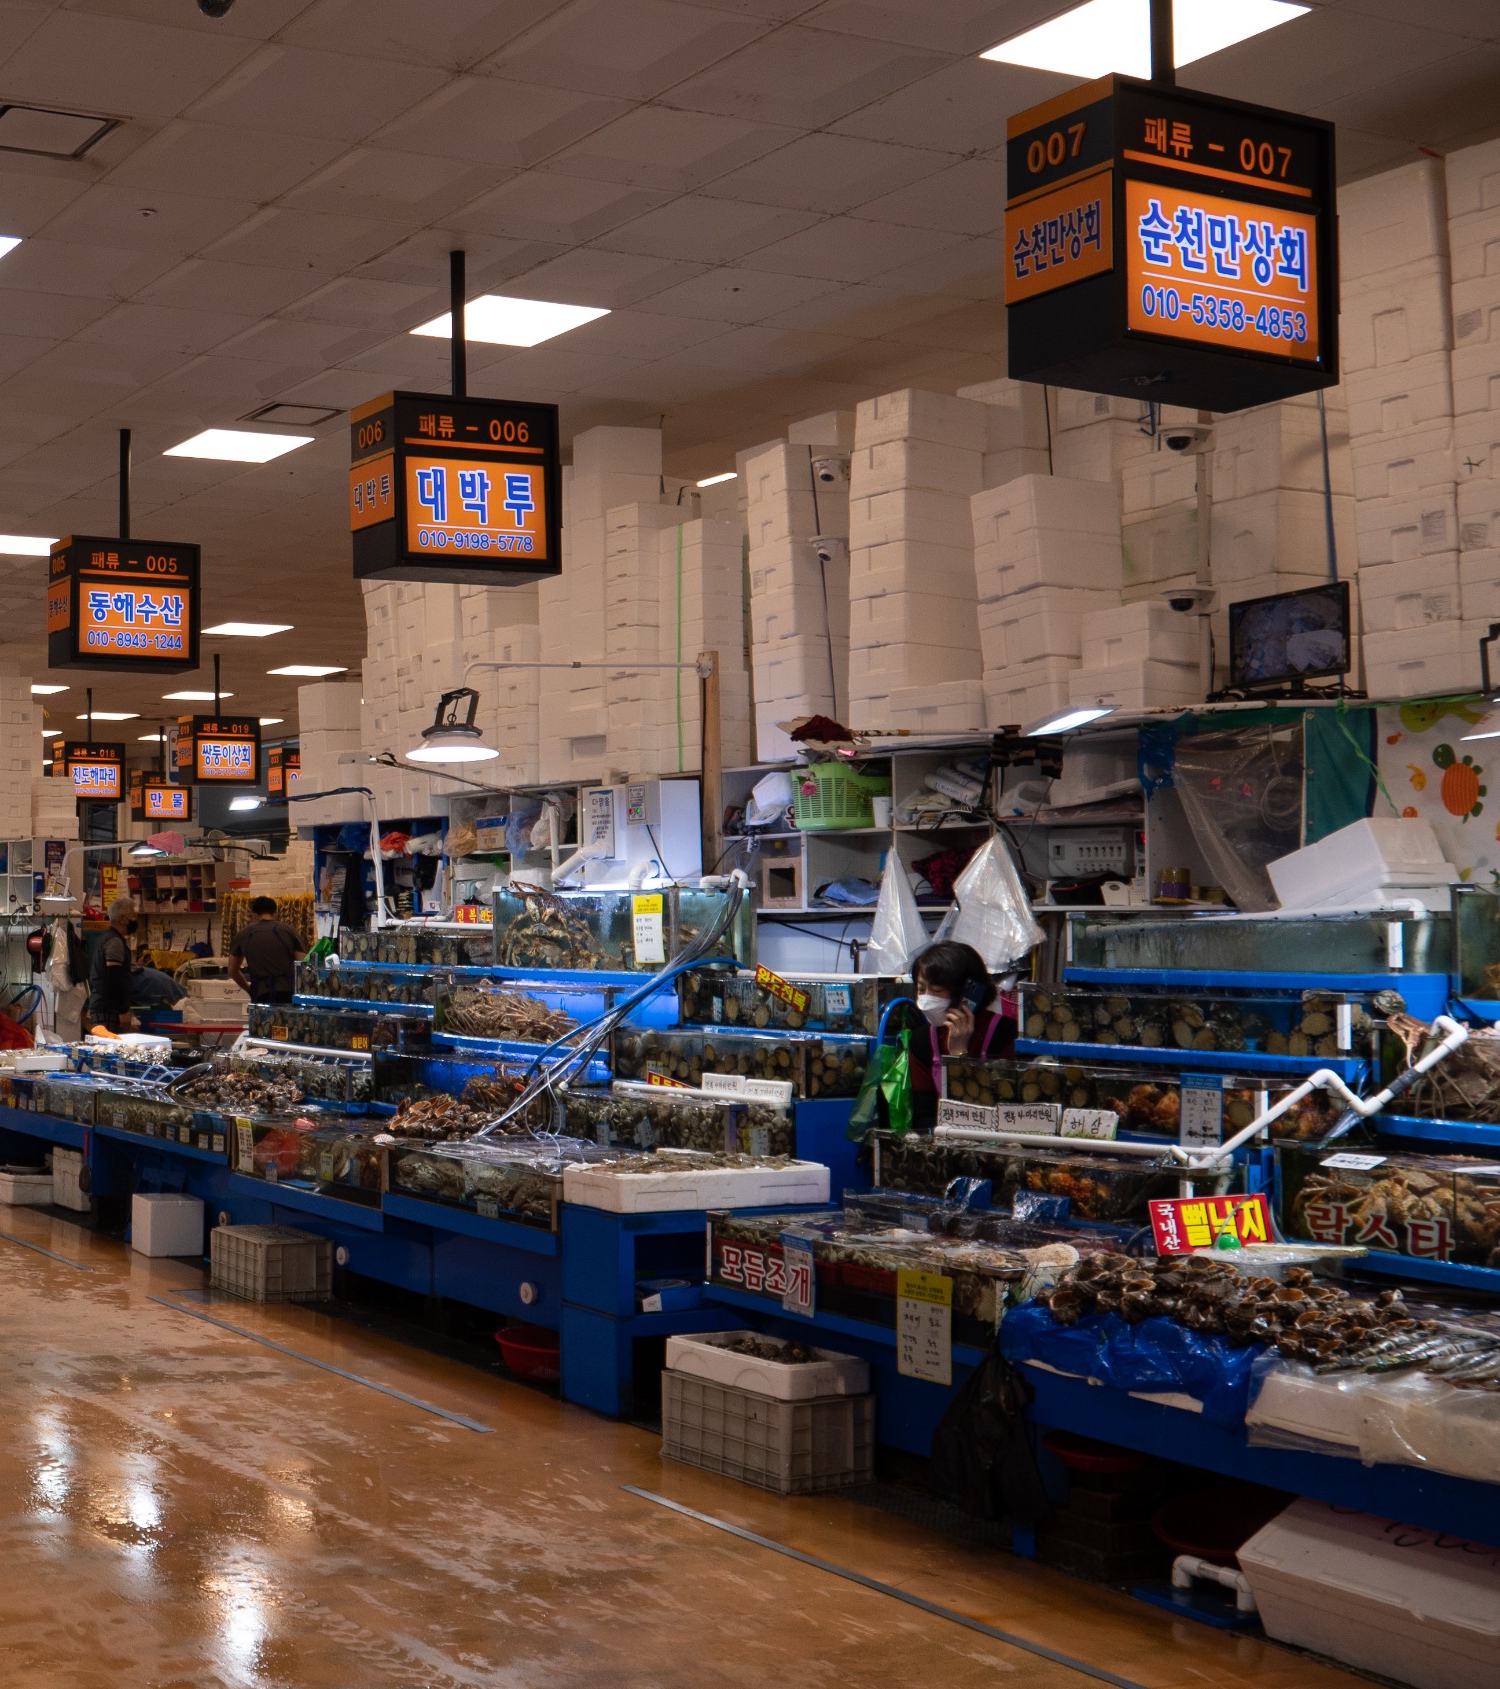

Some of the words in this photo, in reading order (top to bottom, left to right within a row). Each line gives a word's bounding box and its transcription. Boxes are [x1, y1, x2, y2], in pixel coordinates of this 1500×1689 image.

[1028, 122, 1087, 174] 007
[1144, 118, 1193, 158] 패류
[1240, 138, 1292, 177] 007
[1013, 200, 1101, 279] 순천만상회
[1139, 199, 1309, 293] 순천만상회
[1142, 284, 1307, 343] 010-5358-4853
[358, 420, 383, 448] 006
[418, 414, 455, 438] 패류
[489, 420, 529, 443] 006
[419, 530, 534, 552] 010-9198-5778
[52, 555, 66, 574] 005
[91, 552, 120, 569] 패류
[147, 556, 178, 573] 005
[88, 591, 184, 626] 동해수산
[87, 631, 183, 650] 010-8943-1244
[232, 724, 249, 733] 019
[202, 744, 252, 767] 쌍둥이상회
[72, 766, 117, 787] 진도해파리
[757, 967, 807, 1012] 완도전복
[1157, 1203, 1181, 1250] 국내산
[1181, 1199, 1268, 1247] 뻘낙지
[720, 1245, 809, 1307] 모듬조개
